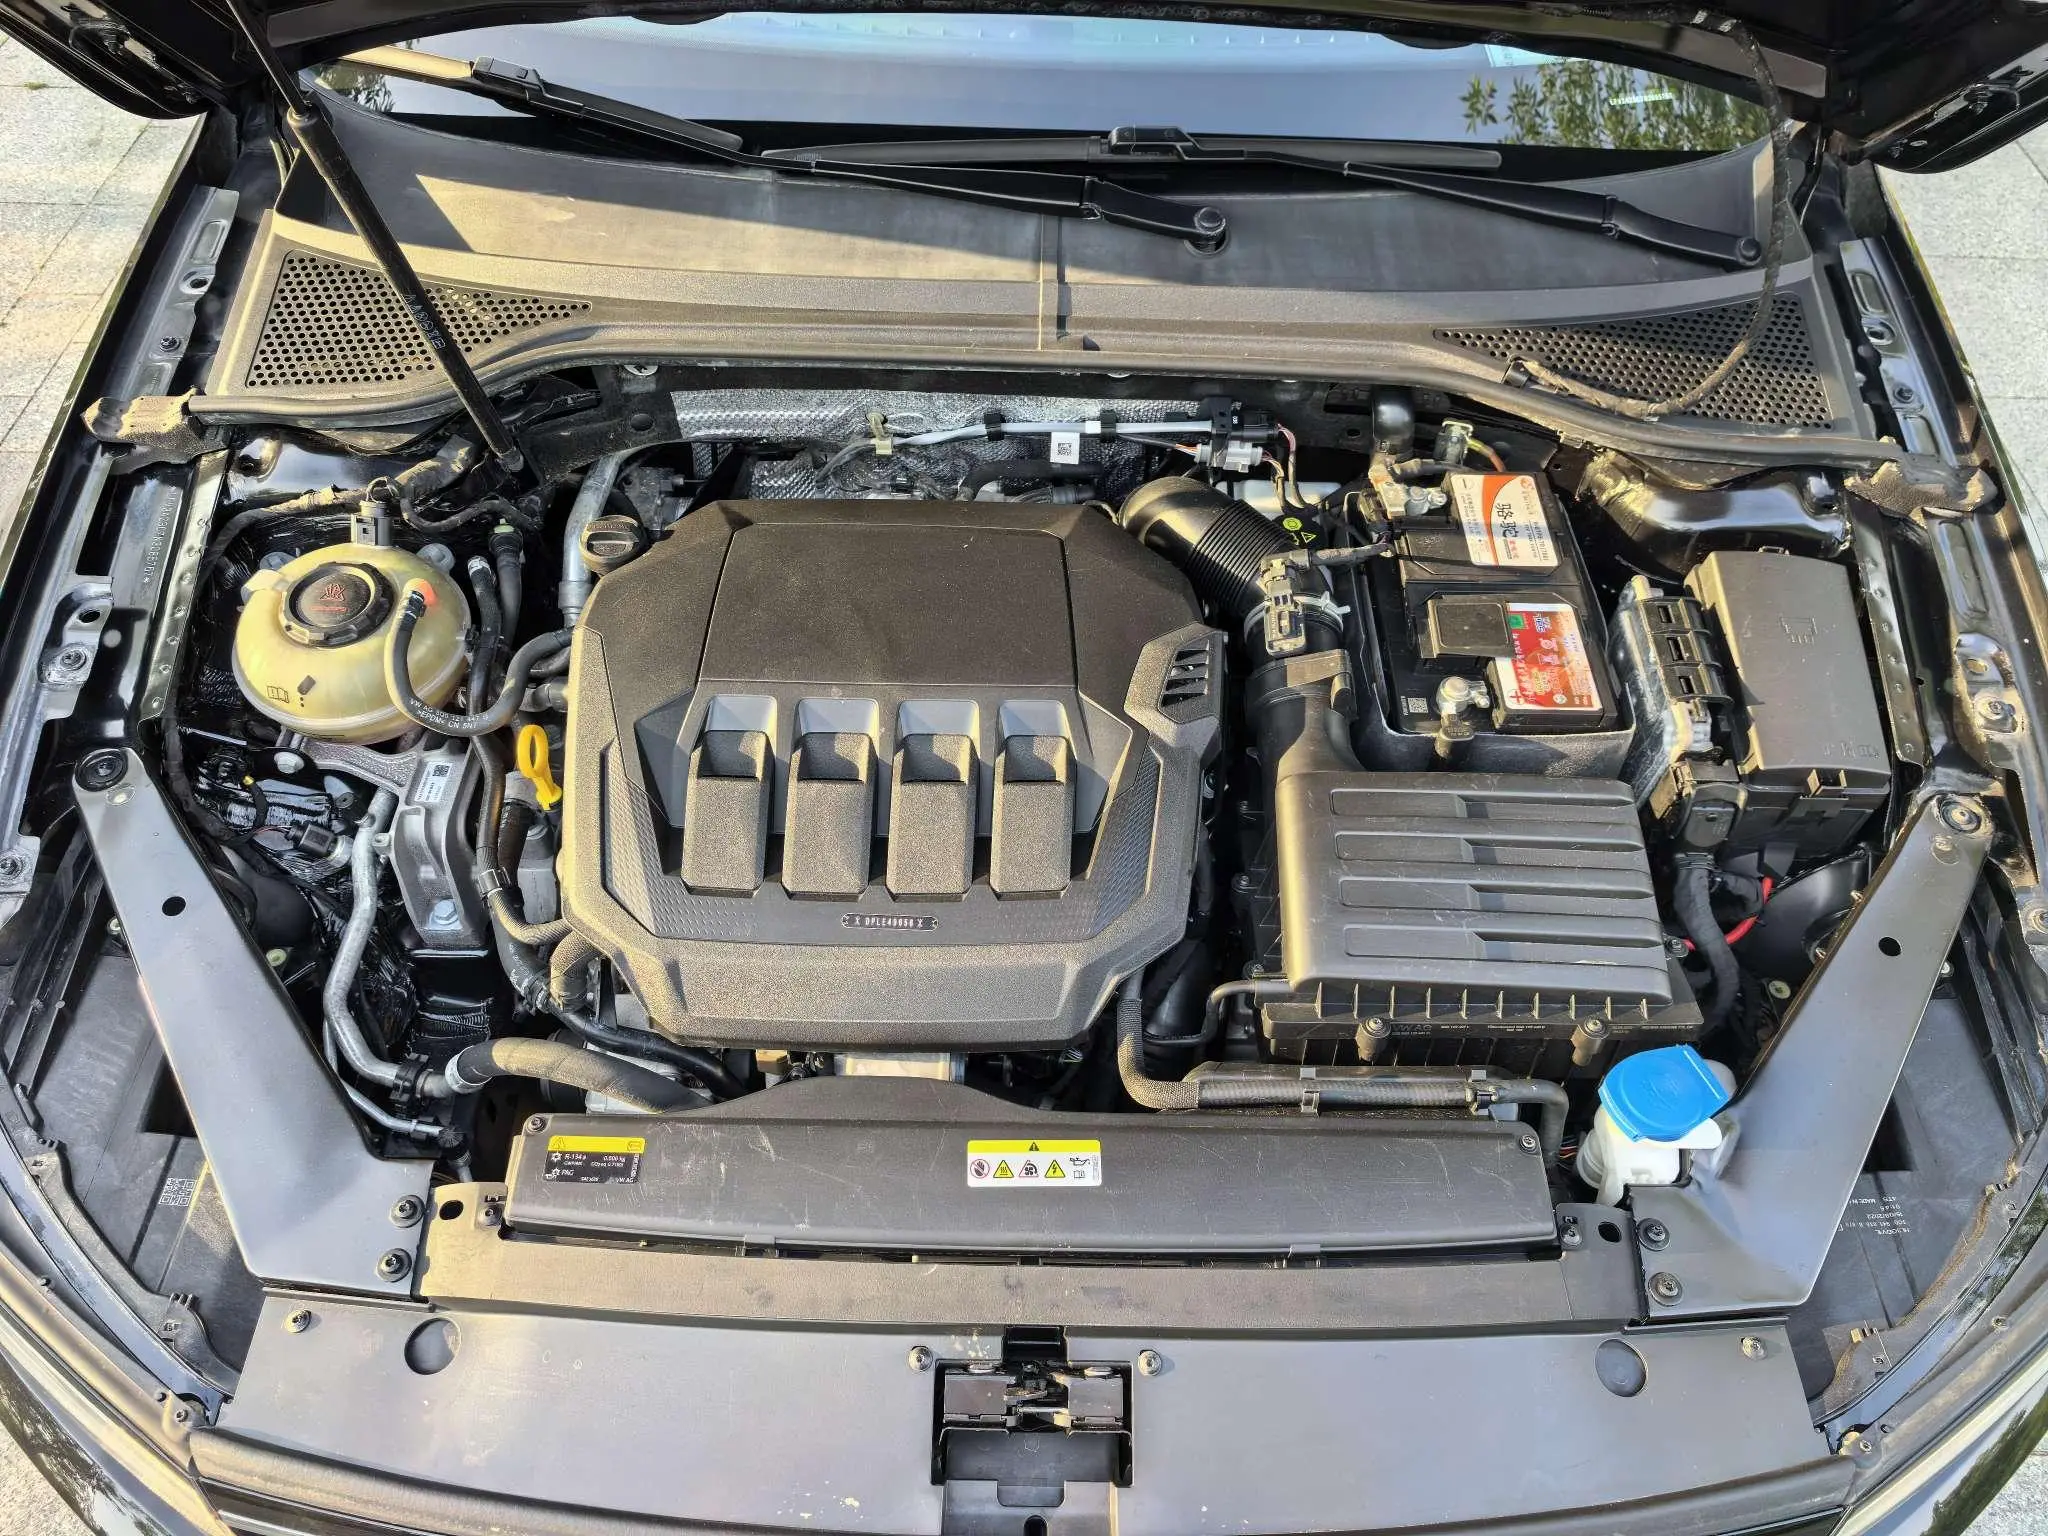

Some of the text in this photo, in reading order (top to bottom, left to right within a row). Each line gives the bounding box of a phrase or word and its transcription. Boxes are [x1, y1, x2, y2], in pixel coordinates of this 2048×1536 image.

[1495, 503, 1519, 538] 骆驼
[410, 698, 422, 708] VW
[448, 721, 460, 729] CN
